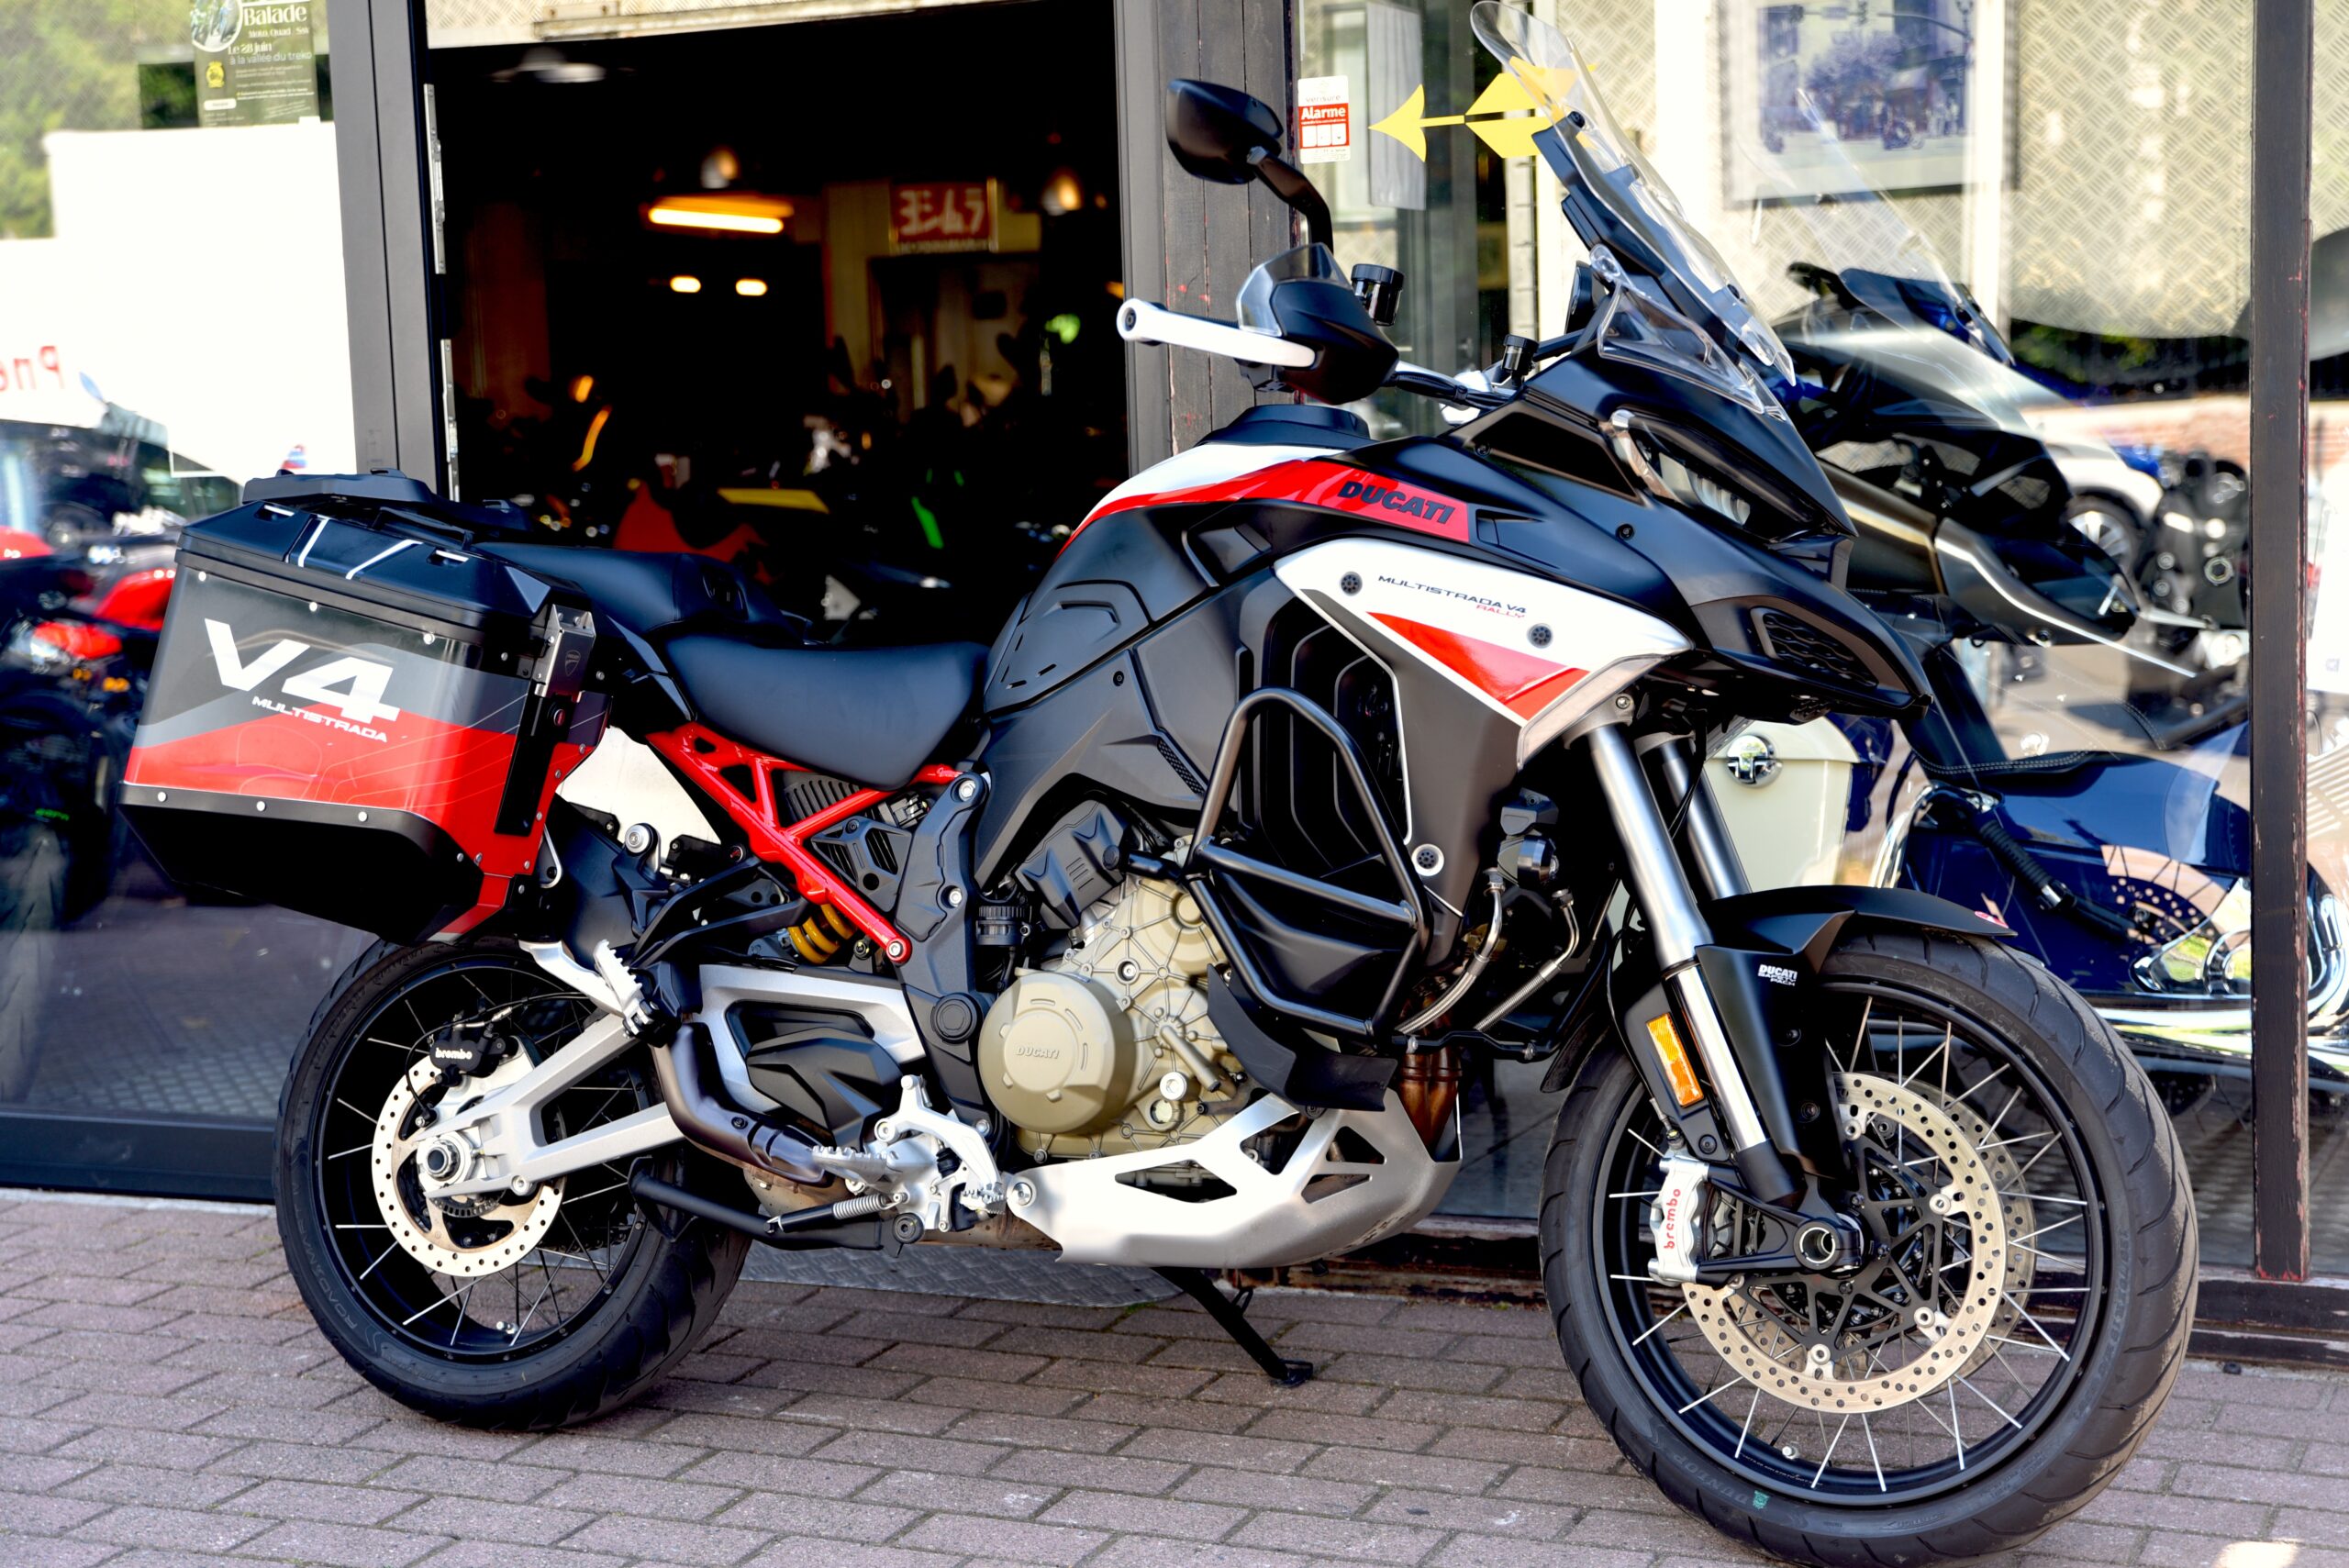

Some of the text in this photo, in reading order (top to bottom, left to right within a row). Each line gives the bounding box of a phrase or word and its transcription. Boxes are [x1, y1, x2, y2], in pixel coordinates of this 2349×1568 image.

[243, 5, 307, 27] Balade
[1301, 106, 1346, 120] Alarme
[1337, 480, 1456, 525] DUCATI
[1378, 575, 1527, 614] MULTISTRADA V4
[1475, 604, 1525, 618] RALLY
[204, 617, 401, 724] V4
[251, 695, 387, 742] MULTISTRADA
[1758, 963, 1798, 980] DUCATI
[434, 1047, 473, 1061] brembo
[1016, 1046, 1060, 1060] DUCATI
[1664, 1188, 1681, 1250] brembo
